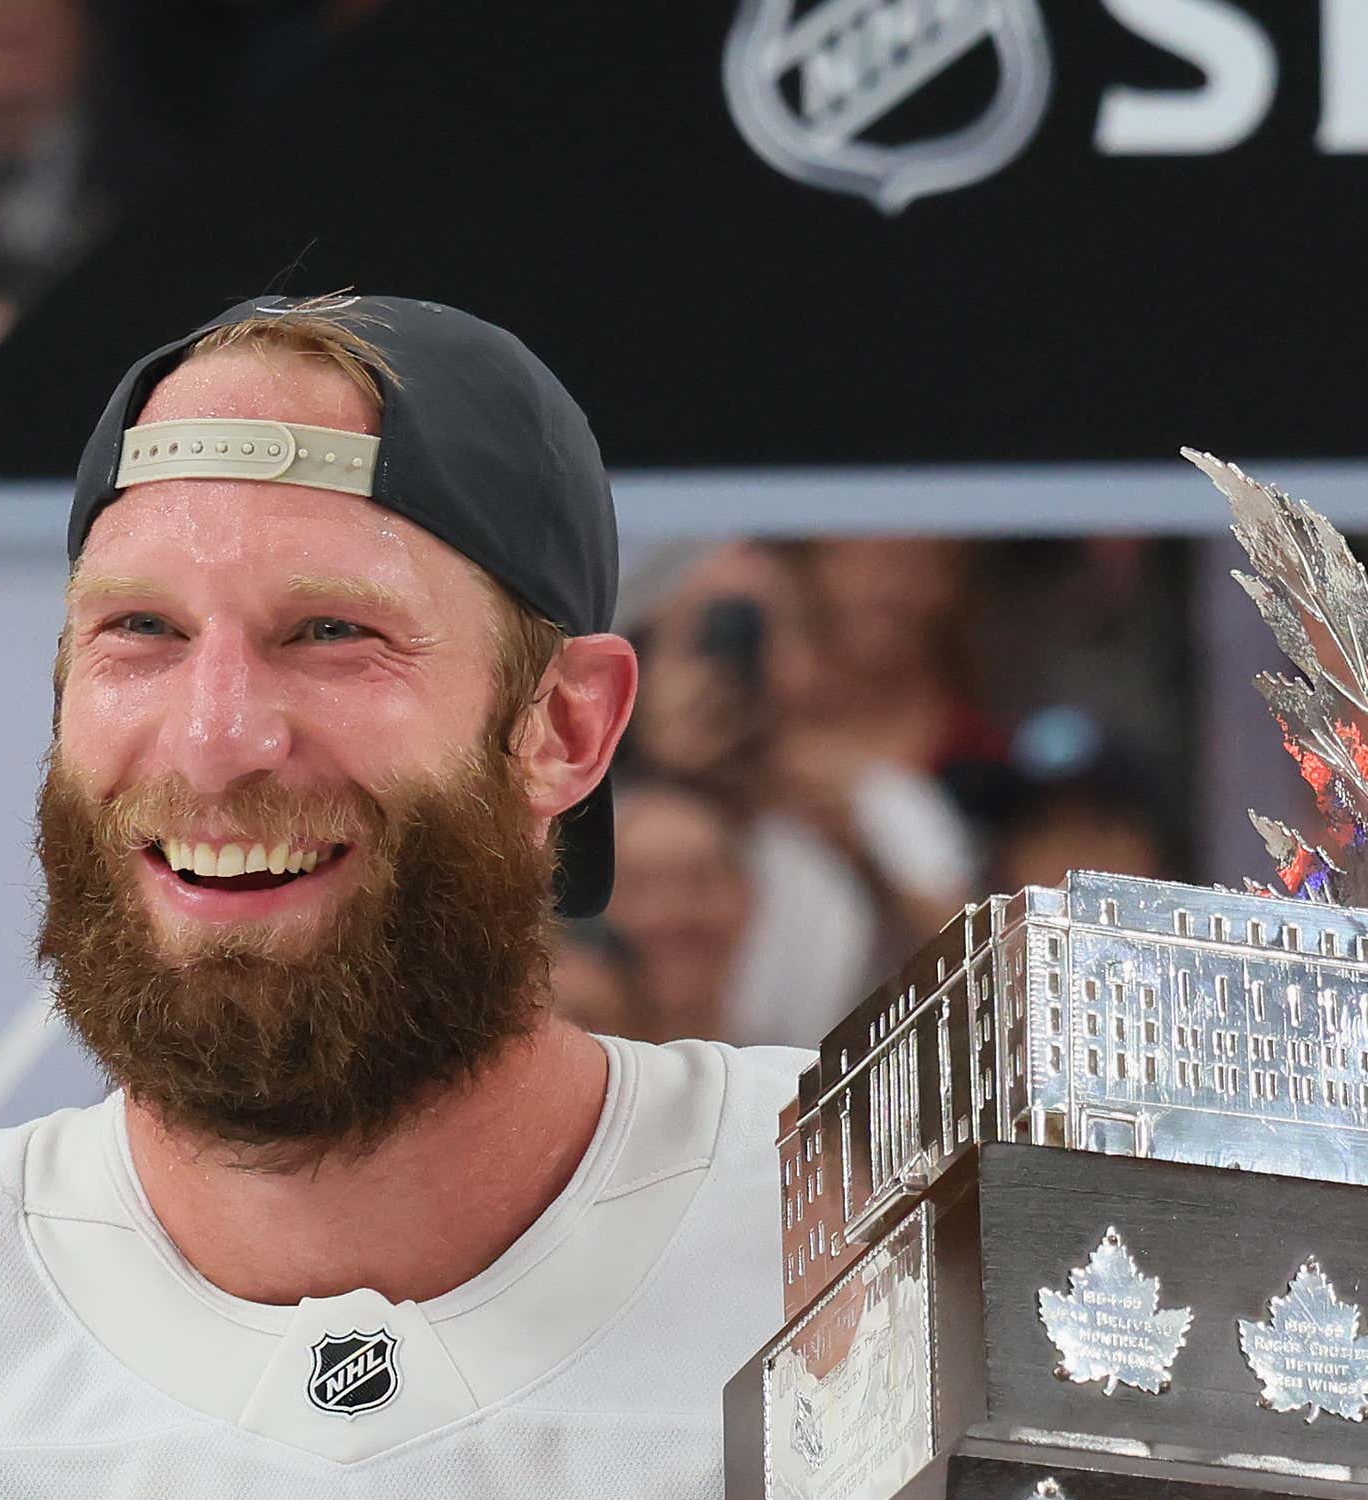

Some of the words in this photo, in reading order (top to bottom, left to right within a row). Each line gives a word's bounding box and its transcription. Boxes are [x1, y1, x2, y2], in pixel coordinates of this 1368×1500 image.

[325, 1348, 384, 1401] NHL
[1285, 1357, 1351, 1375] DETROIT
[1307, 1377, 1358, 1395] WINGS
